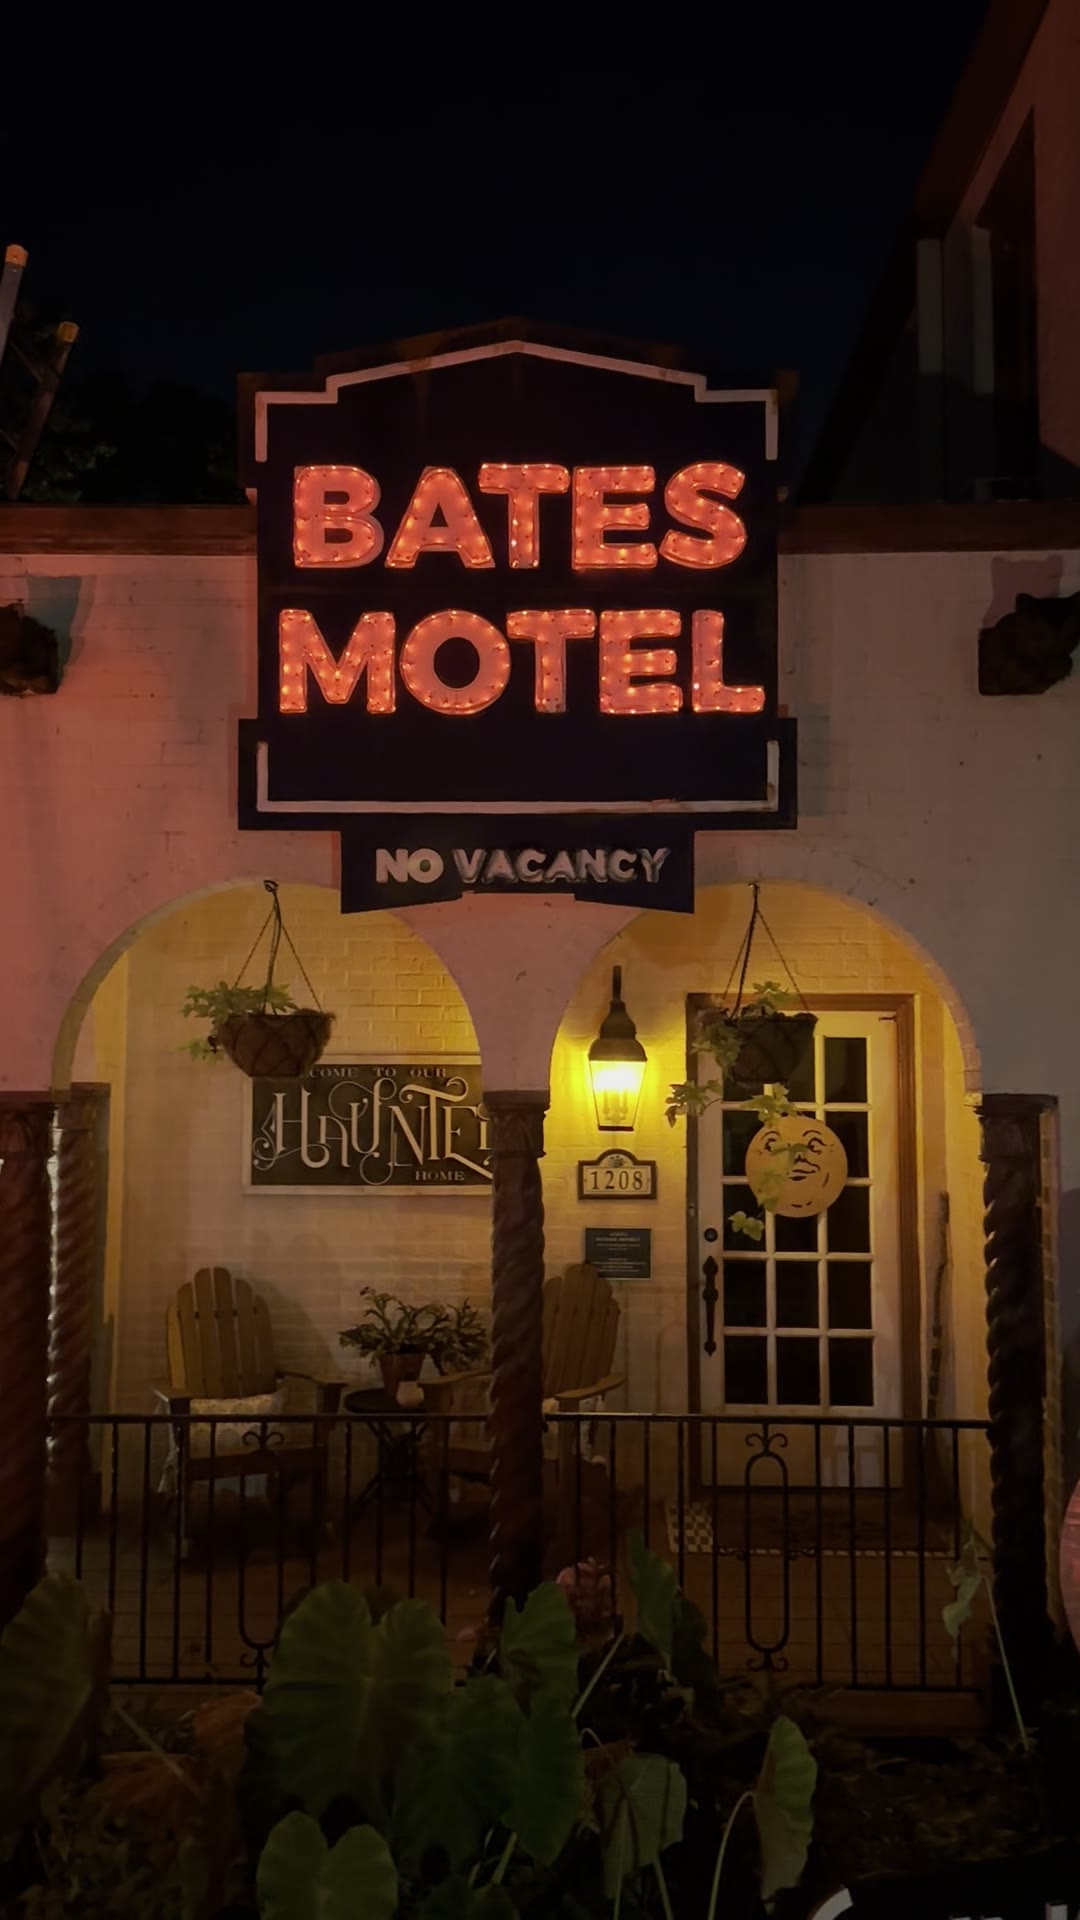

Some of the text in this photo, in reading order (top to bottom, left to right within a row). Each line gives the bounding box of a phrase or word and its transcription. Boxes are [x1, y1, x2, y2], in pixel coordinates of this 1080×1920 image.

[293, 462, 748, 570] BATES
[278, 608, 766, 715] MOTEL
[375, 848, 670, 884] NO VACANCY
[372, 1066, 397, 1079] TO
[410, 1066, 447, 1079] OUR
[415, 1170, 464, 1181] HOME
[590, 1170, 643, 1190] 1208
